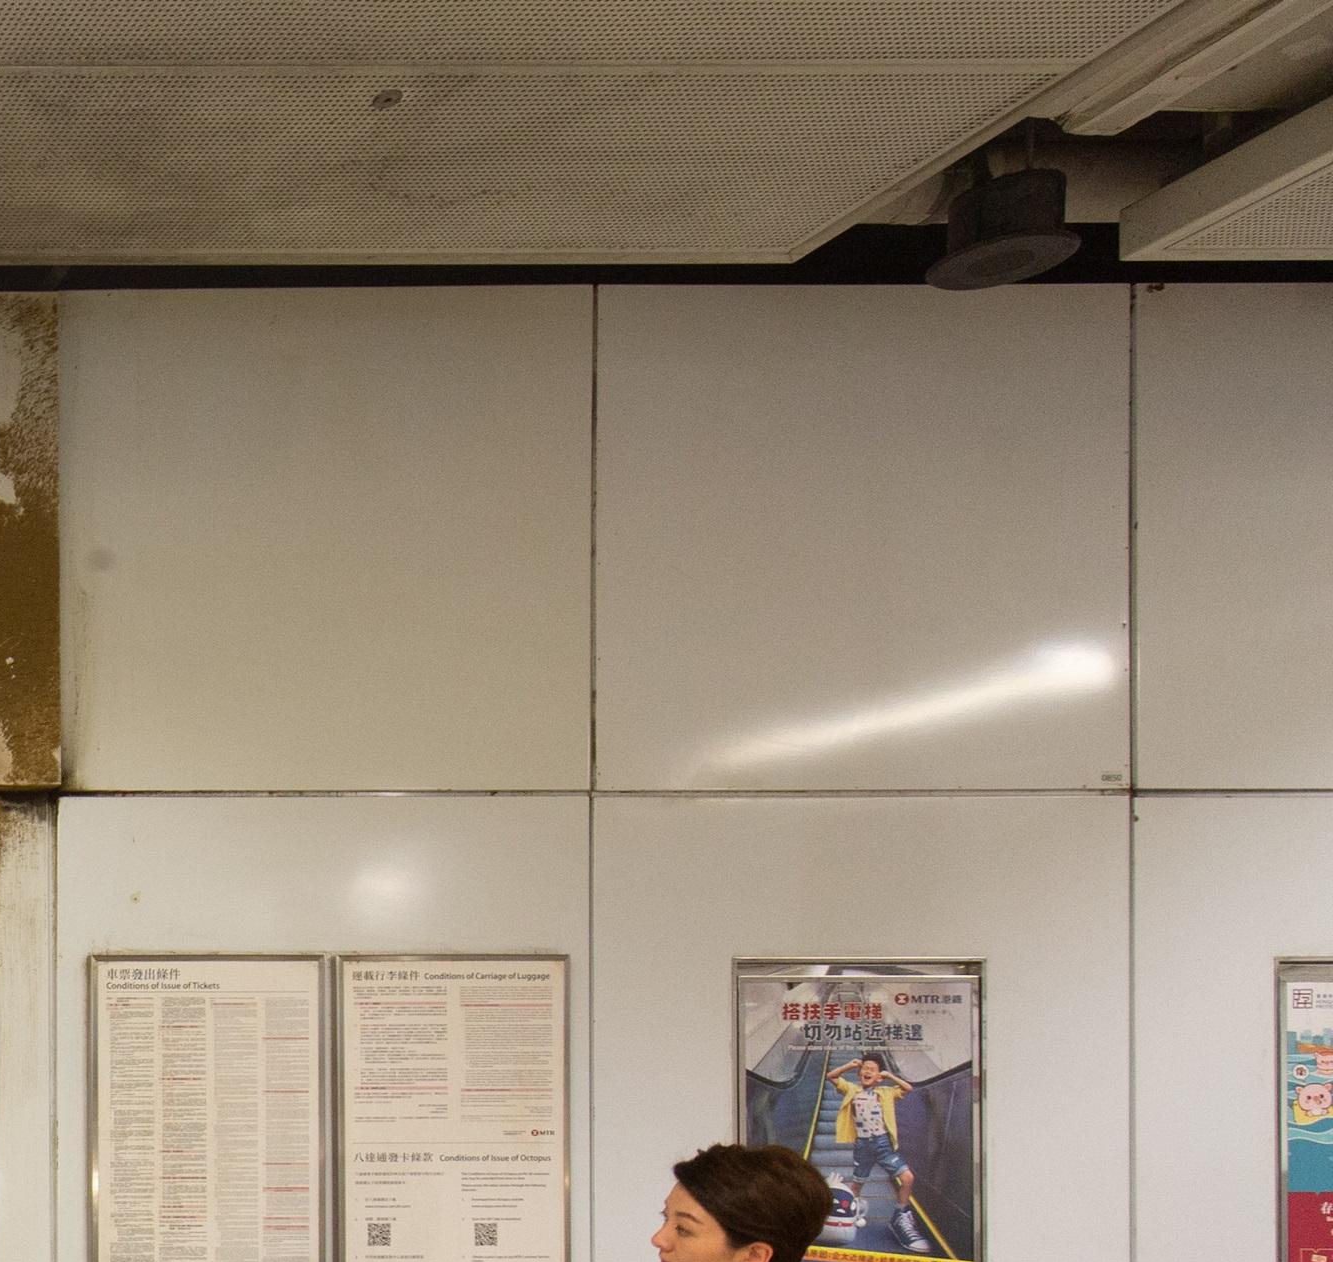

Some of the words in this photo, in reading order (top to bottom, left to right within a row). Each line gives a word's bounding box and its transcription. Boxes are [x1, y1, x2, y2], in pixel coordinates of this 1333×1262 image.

[424, 972, 465, 981] Conditions
[466, 972, 474, 981] of
[475, 972, 507, 983] Carriage
[508, 972, 516, 981] of
[517, 972, 550, 983] Luggage
[106, 981, 149, 990] Conditions
[151, 981, 160, 990] of
[161, 981, 181, 990] Issue
[183, 981, 191, 990] of
[192, 981, 220, 990] Tickets
[782, 1002, 882, 1020] 搭扶手電梯
[804, 1023, 923, 1041] 切勿站近梯邊
[353, 1152, 433, 1163] 八達通發卡條款
[439, 1154, 481, 1162] Conditions
[482, 1154, 489, 1162] of
[490, 1154, 509, 1162] Issue
[510, 1154, 519, 1162] of
[520, 1154, 552, 1163] Octopus
